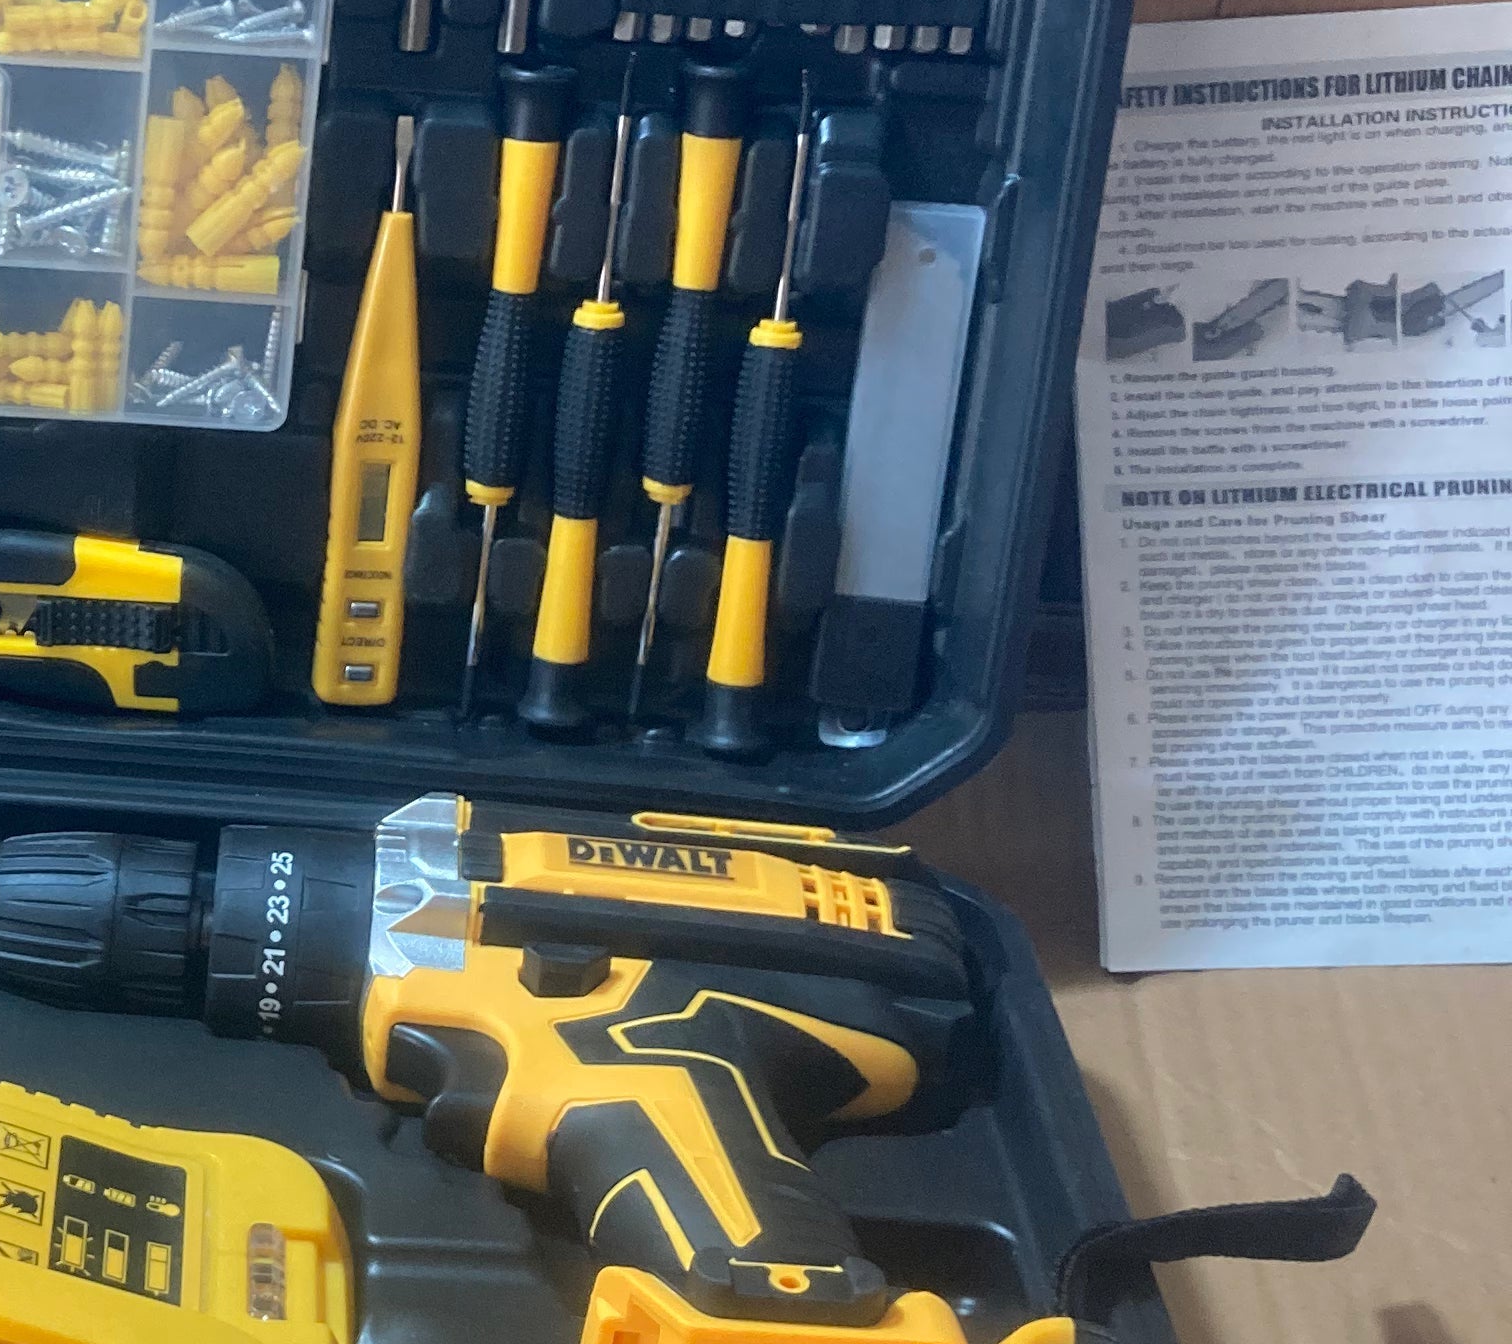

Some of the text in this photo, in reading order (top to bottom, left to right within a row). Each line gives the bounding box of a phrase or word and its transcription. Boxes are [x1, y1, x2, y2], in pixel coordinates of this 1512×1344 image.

[1324, 73, 1361, 98] FOR
[1365, 68, 1446, 95] LITHIUM
[1261, 109, 1401, 131] INSTALLATION
[1122, 489, 1172, 506] NOTE
[1178, 489, 1206, 505] ON
[1211, 486, 1298, 504] LITHIUM
[1304, 482, 1428, 501] ELECTRICAL
[340, 636, 385, 648] DIRECT
[258, 851, 294, 1020] 19 21 23 25
